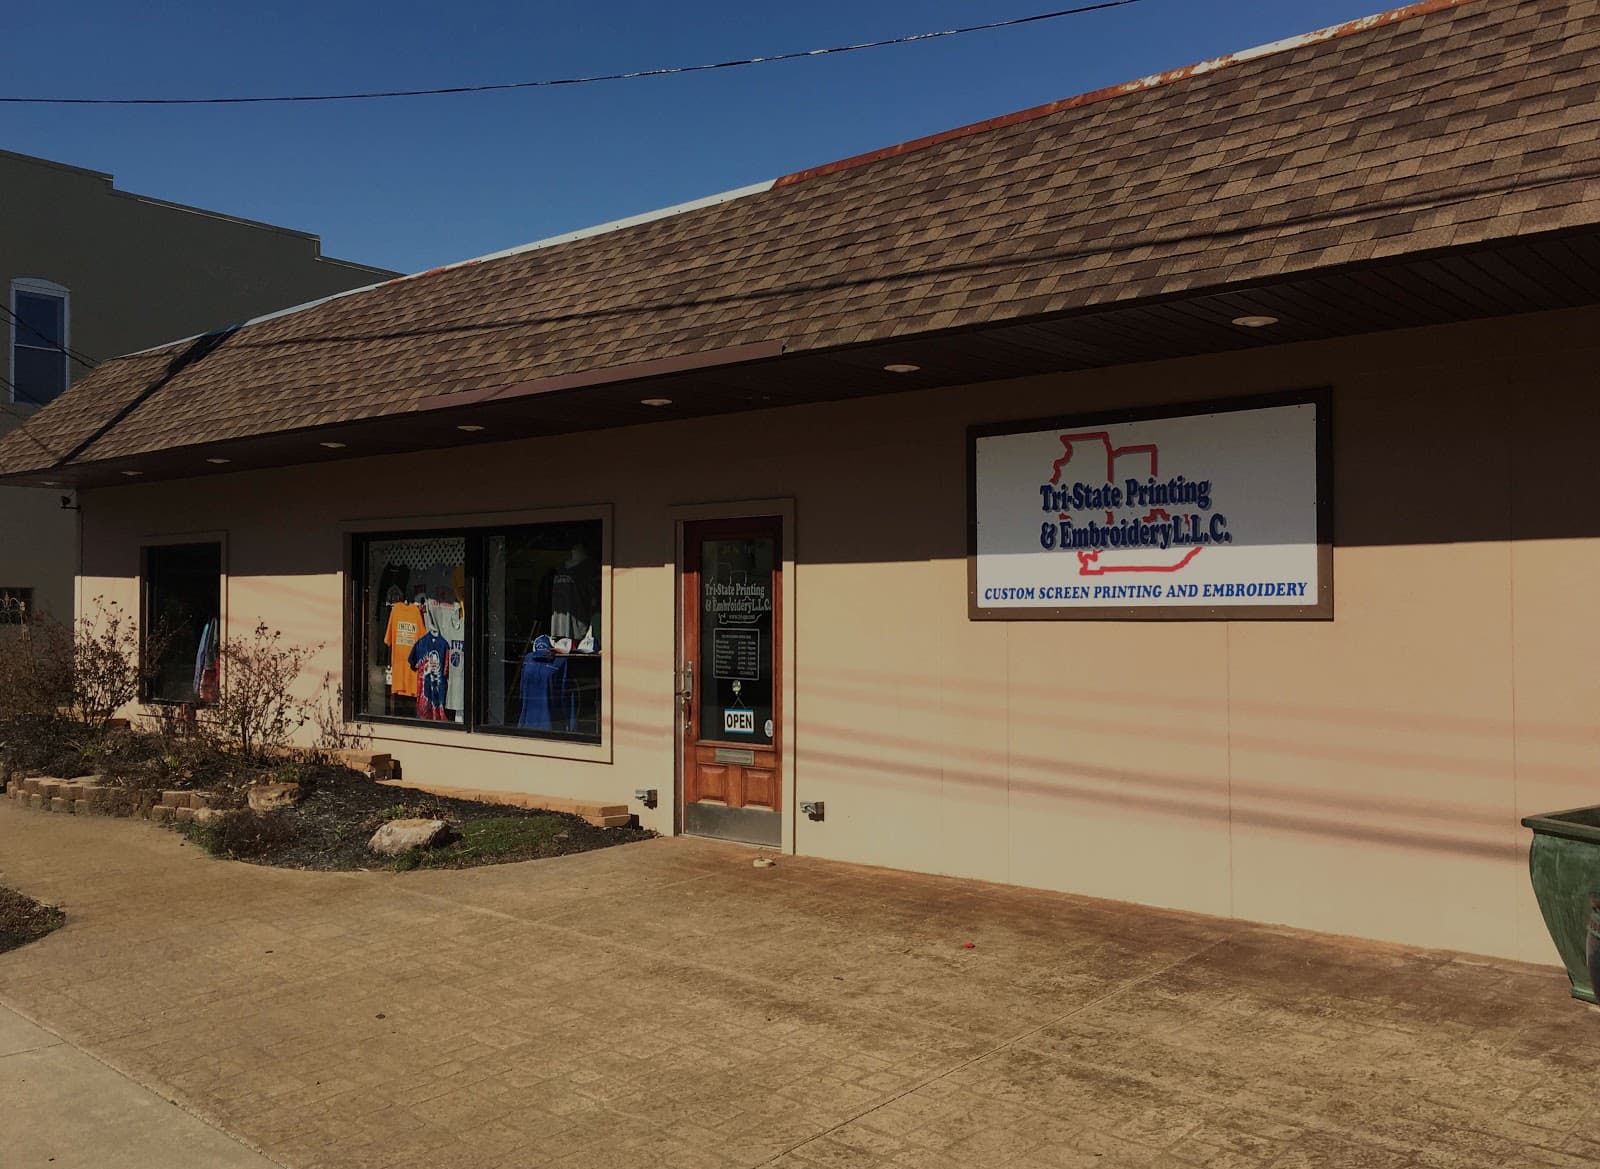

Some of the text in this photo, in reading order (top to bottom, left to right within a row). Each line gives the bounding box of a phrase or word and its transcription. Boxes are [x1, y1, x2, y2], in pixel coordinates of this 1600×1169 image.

[1040, 476, 1210, 511] Tri-State Printing
[1040, 522, 1057, 549] &
[704, 583, 765, 598] Tri-State Printing
[985, 582, 1308, 600] CUSTOM SCREEN PRINTING AND EMBROIDERY
[726, 713, 752, 729] OPEN
